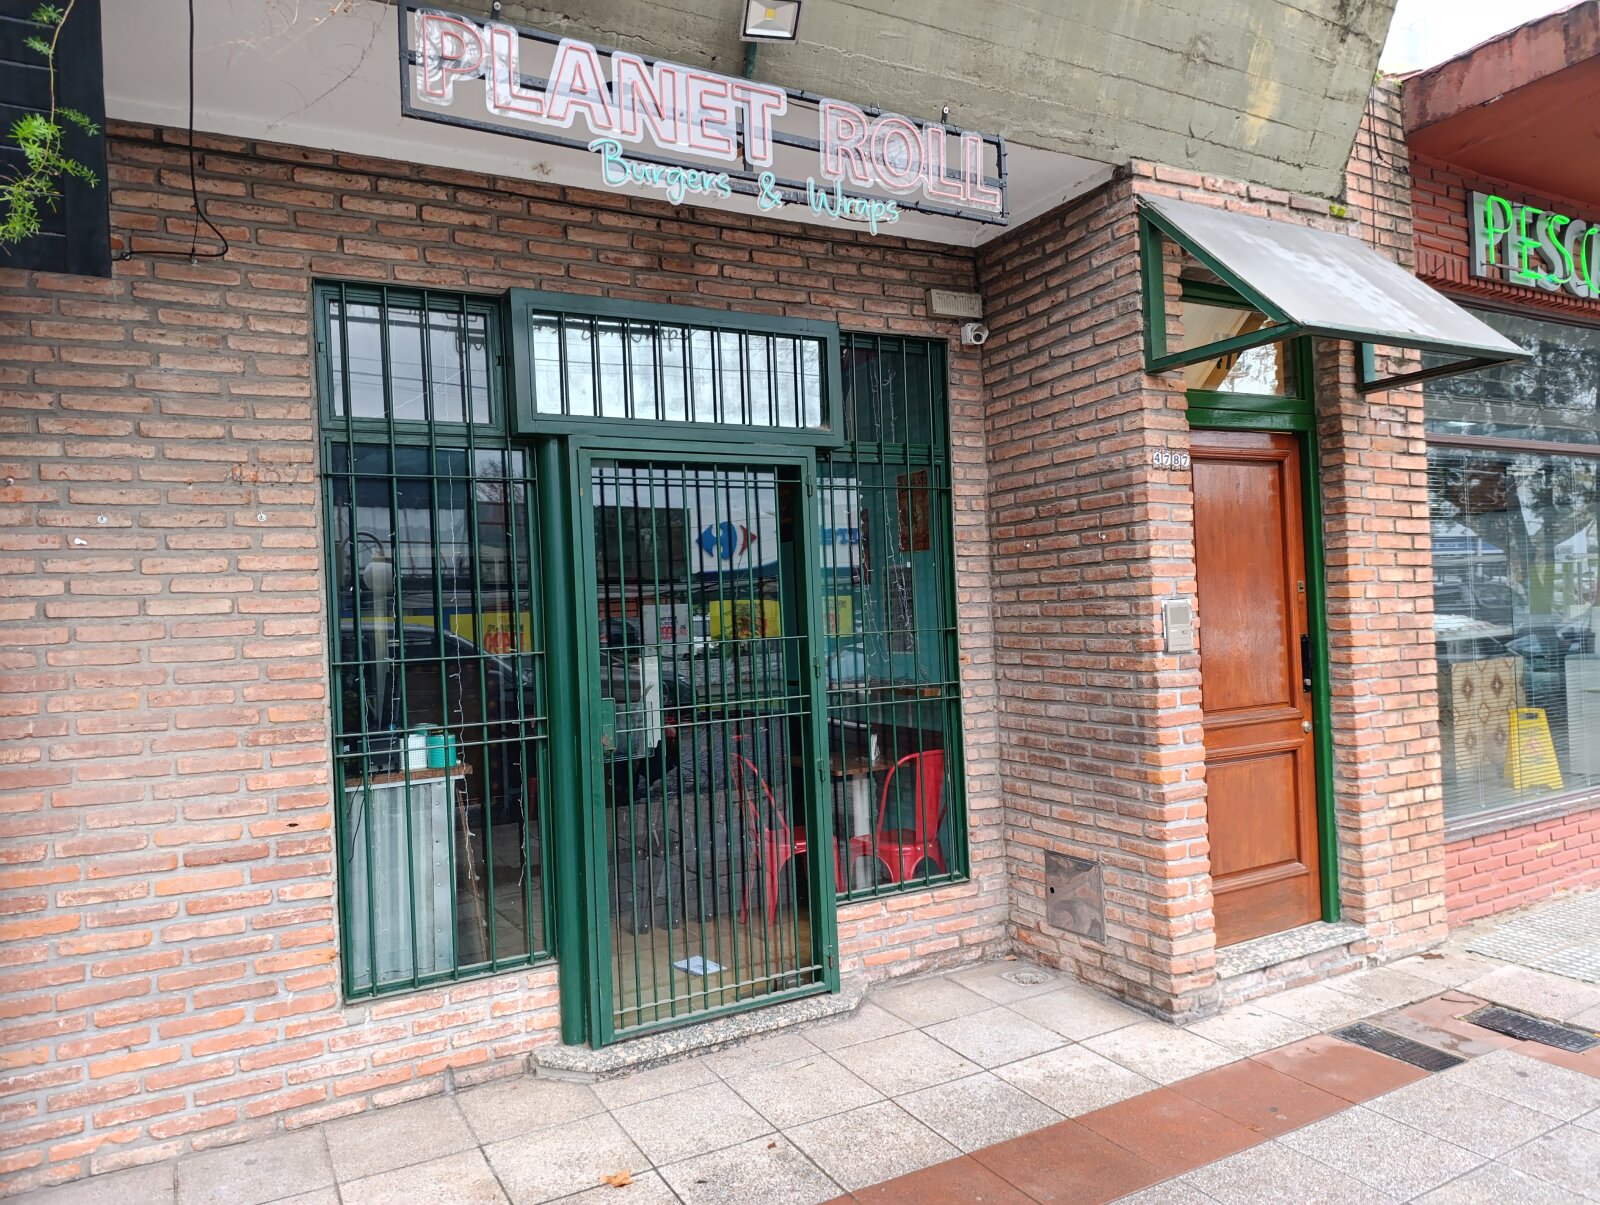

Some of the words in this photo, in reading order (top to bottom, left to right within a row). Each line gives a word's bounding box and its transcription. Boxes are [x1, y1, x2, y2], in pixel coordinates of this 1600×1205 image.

[418, 13, 784, 161] PLANET
[824, 103, 1001, 206] ROLL
[592, 139, 732, 203] Burgers
[758, 173, 784, 211] &
[808, 176, 900, 234] Wraps
[1154, 452, 1189, 467] 4787
